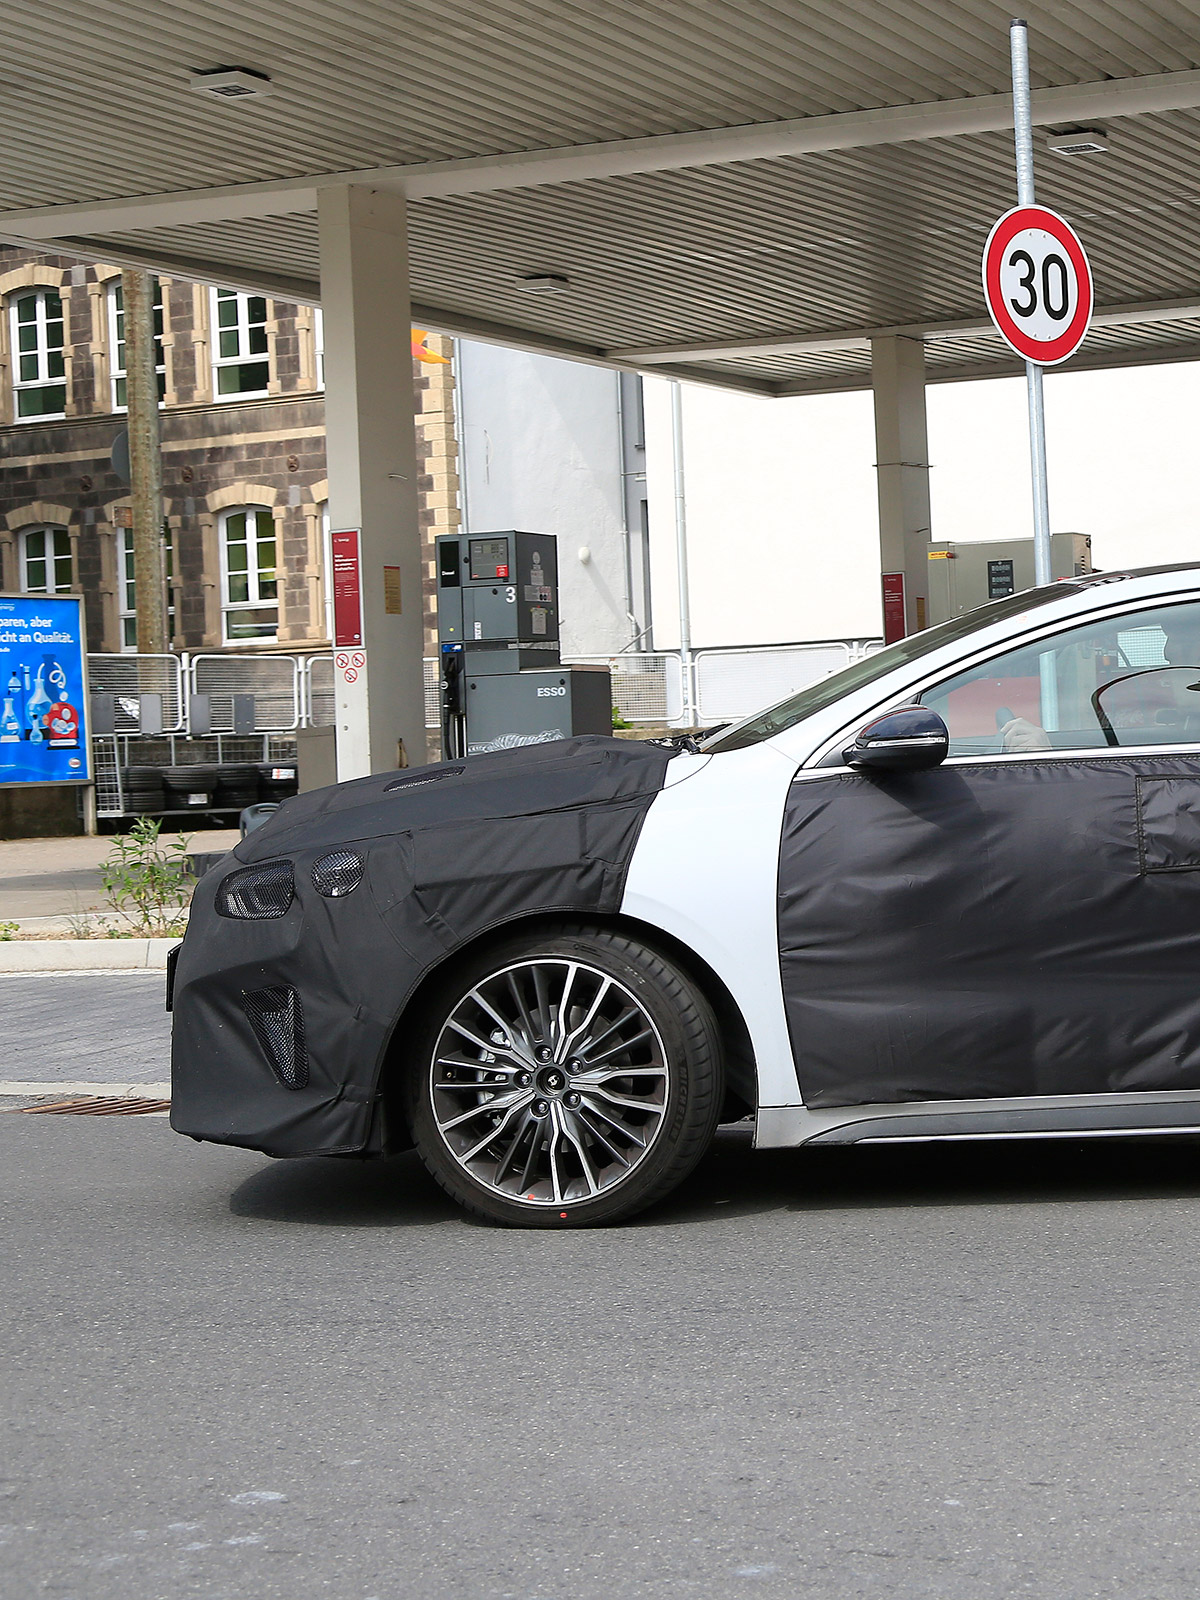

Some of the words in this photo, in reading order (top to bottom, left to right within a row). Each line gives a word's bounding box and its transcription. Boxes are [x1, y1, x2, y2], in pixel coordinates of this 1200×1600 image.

[1009, 250, 1069, 320] 30
[505, 586, 516, 603] 3
[30, 616, 53, 627] aber
[19, 634, 32, 643] an
[33, 631, 74, 644] Qualität.
[537, 687, 566, 697] ESSO
[669, 1065, 688, 1140] MICHELIN
